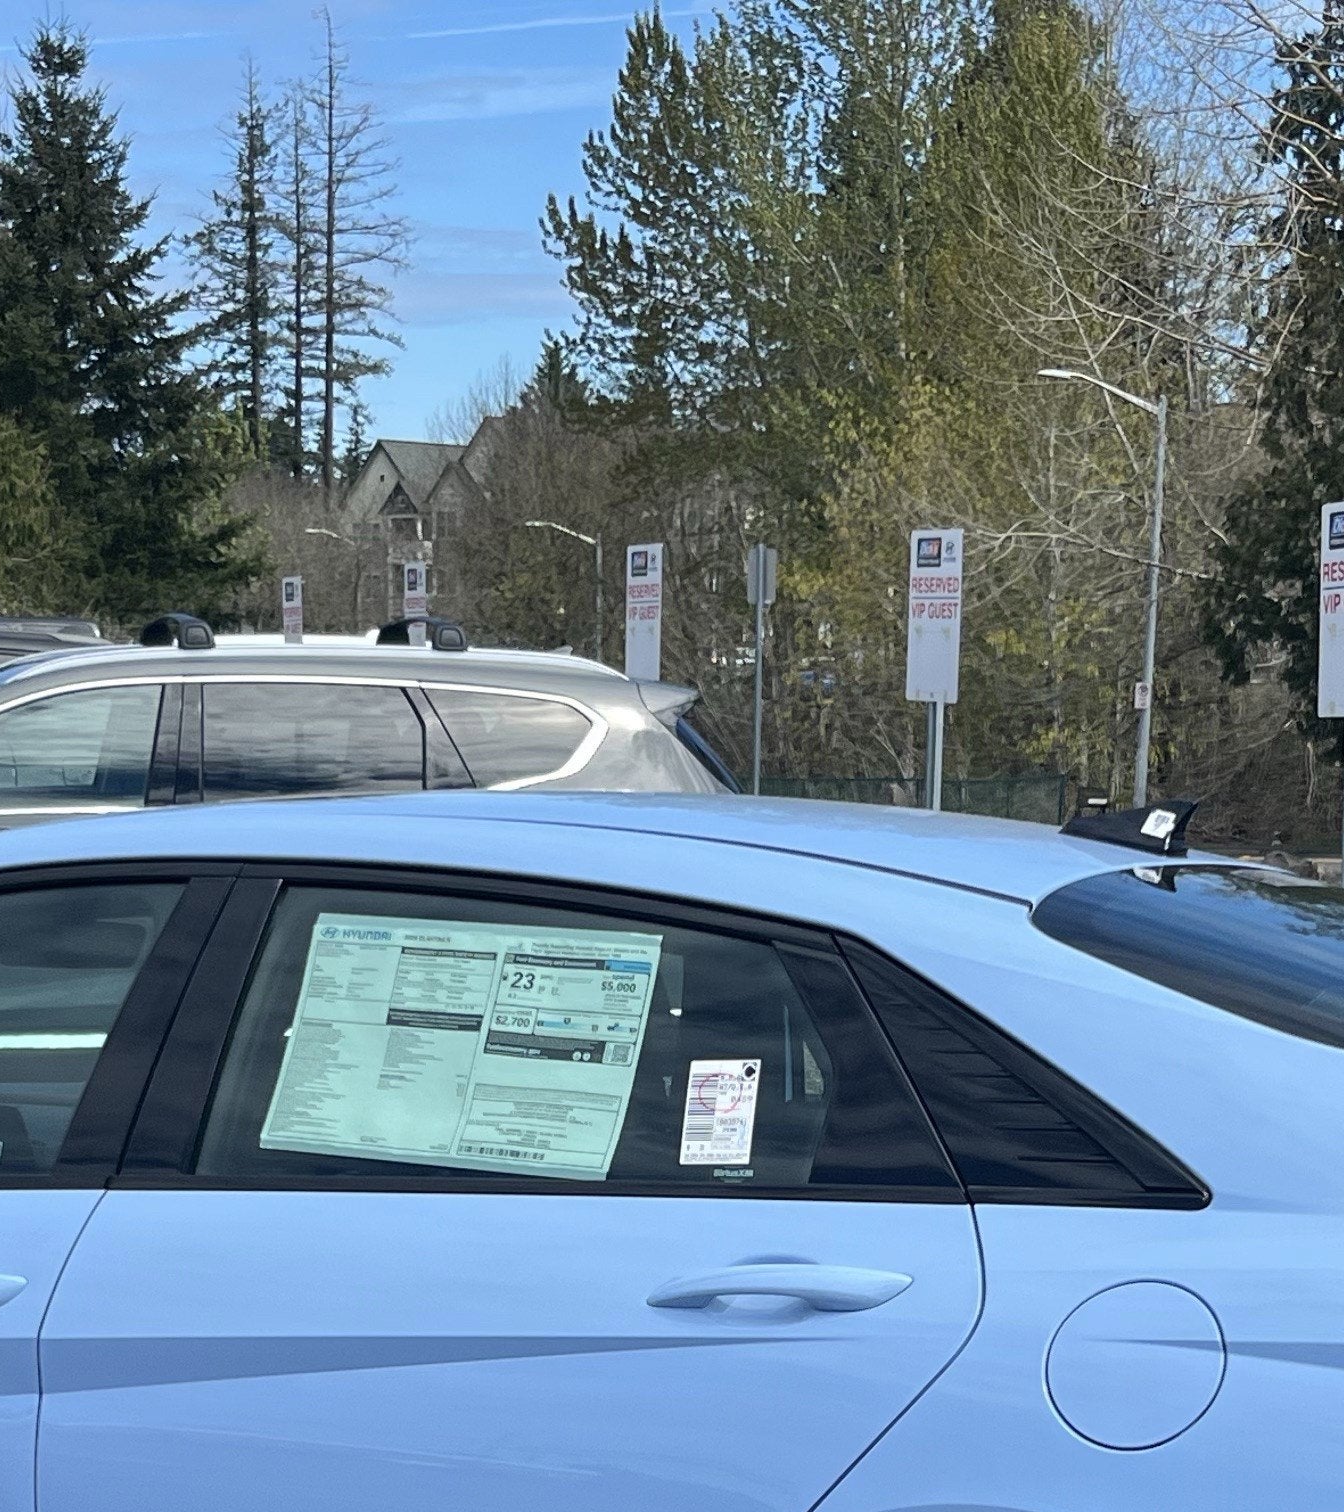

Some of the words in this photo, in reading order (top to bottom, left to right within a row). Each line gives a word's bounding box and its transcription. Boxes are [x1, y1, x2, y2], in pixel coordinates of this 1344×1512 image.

[911, 576, 959, 593] RESERVED
[911, 602, 926, 618] VIP
[928, 602, 959, 619] GUEST
[1323, 593, 1341, 614] VIP
[342, 929, 392, 941] HYUNDAI
[510, 971, 536, 990] 23
